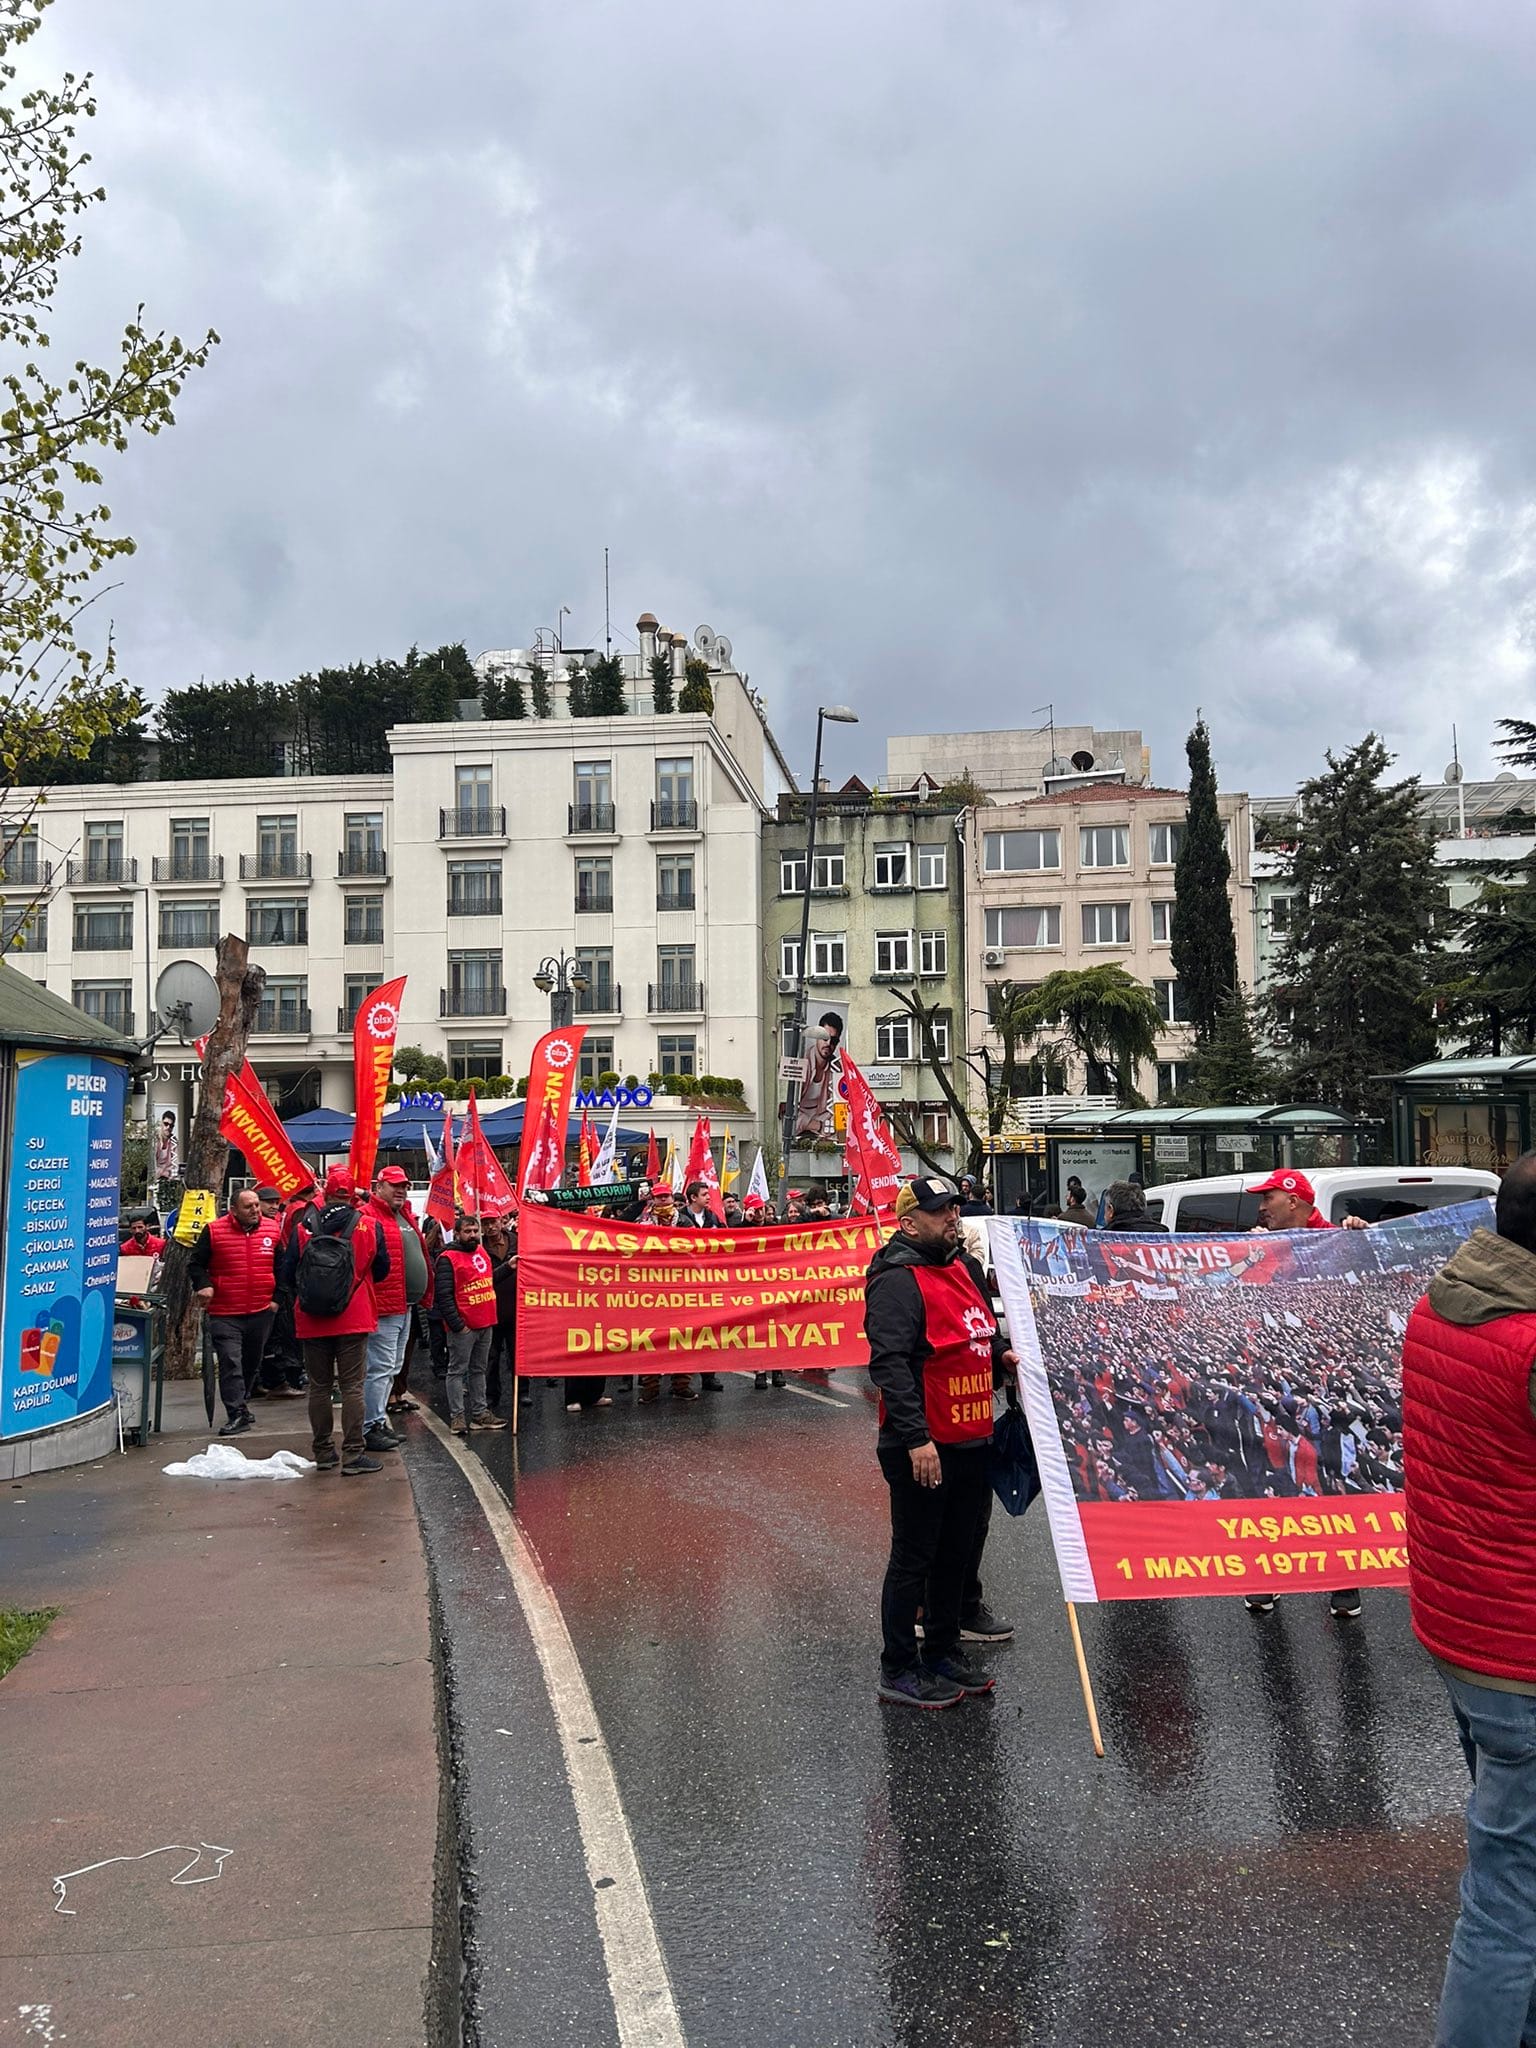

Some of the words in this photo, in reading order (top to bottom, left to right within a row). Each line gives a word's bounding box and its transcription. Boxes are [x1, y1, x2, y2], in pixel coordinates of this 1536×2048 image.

[373, 1014, 392, 1025] DİSK
[66, 1074, 107, 1092] PEKER
[71, 1096, 103, 1116] BÜFE
[575, 1085, 653, 1108] MADO
[554, 1190, 573, 1201] Tek
[575, 1187, 592, 1198] Yol
[562, 1227, 736, 1258] YAŞASIN
[752, 1237, 767, 1252] 1
[578, 1264, 620, 1285] İŞÇİ
[628, 1267, 728, 1283] SINIFININ
[736, 1265, 869, 1282] ULUSLARARA
[525, 1289, 599, 1307] BİRLİK
[606, 1291, 724, 1308] MÜCADELE
[731, 1295, 754, 1306] ve
[760, 1288, 865, 1305] DAYANIŞM
[567, 1323, 656, 1352] DİSK
[669, 1319, 845, 1350] NAKLİYAT
[13, 1383, 40, 1398] KART
[42, 1373, 77, 1391] DOLUMU
[1217, 1514, 1356, 1542] YAŞASIN
[1364, 1512, 1381, 1532] 1
[1116, 1558, 1133, 1579] 1
[1144, 1556, 1246, 1579] MAYIS
[1255, 1551, 1328, 1575] 1977
